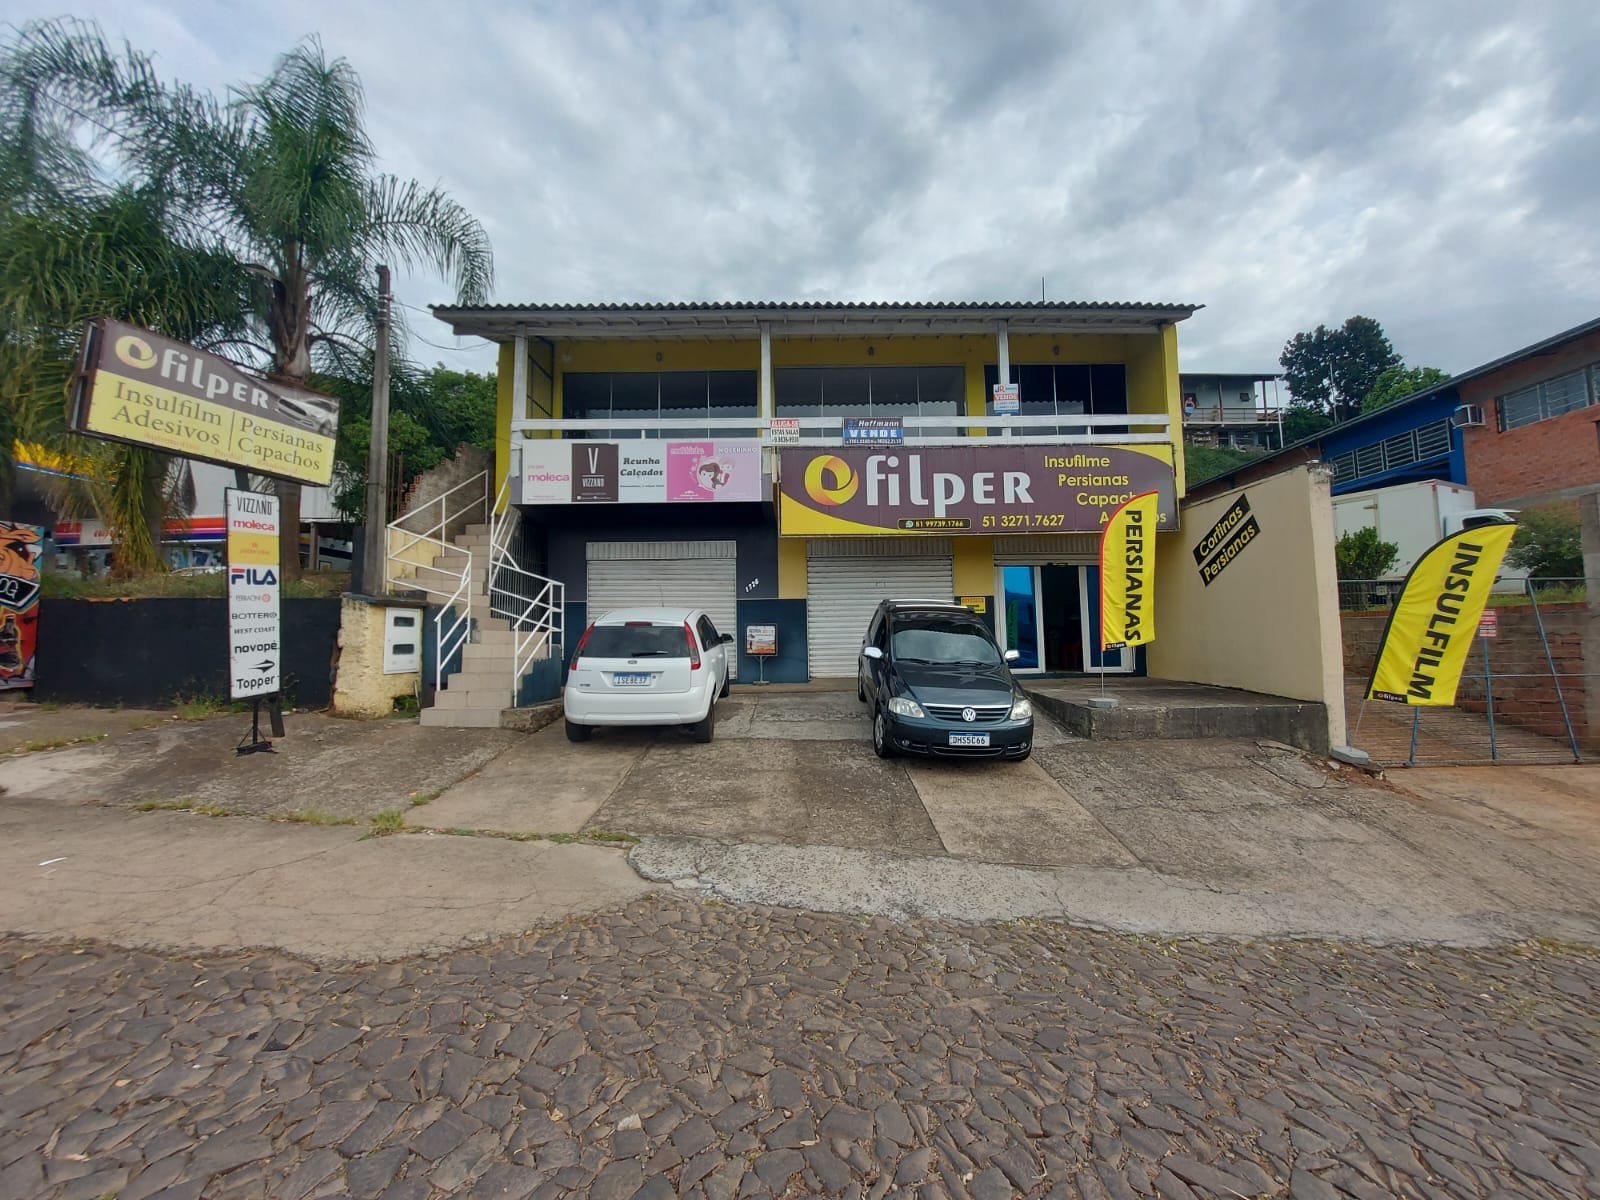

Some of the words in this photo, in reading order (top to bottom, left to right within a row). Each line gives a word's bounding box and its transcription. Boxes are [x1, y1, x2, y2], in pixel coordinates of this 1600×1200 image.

[114, 381, 222, 426] Insulfilm
[112, 405, 220, 446] Adesivos
[240, 416, 323, 453] Persianas
[849, 429, 898, 438] VENDE
[237, 437, 321, 470] Capachos
[588, 447, 599, 474] V
[1044, 455, 1111, 468] Insufilme
[528, 472, 570, 482] moleca
[620, 469, 664, 478] Calçados
[1058, 473, 1129, 487] Persianas
[582, 478, 605, 487] VIZZANO
[236, 495, 273, 516] VIZZANO
[233, 519, 275, 531] moleca
[982, 516, 996, 527] 51
[1001, 514, 1065, 527] 3271.7627
[1199, 505, 1244, 558] Cortinas
[1203, 524, 1256, 581] Persianas
[230, 568, 278, 585] FILA
[1124, 510, 1144, 641] PERSIANAS
[231, 611, 278, 620] BOTTERO
[1407, 542, 1484, 700] INSULFILM
[234, 627, 253, 635] WEST
[254, 625, 276, 633] COAST
[234, 640, 278, 654] novopé
[236, 675, 275, 690] Topper
